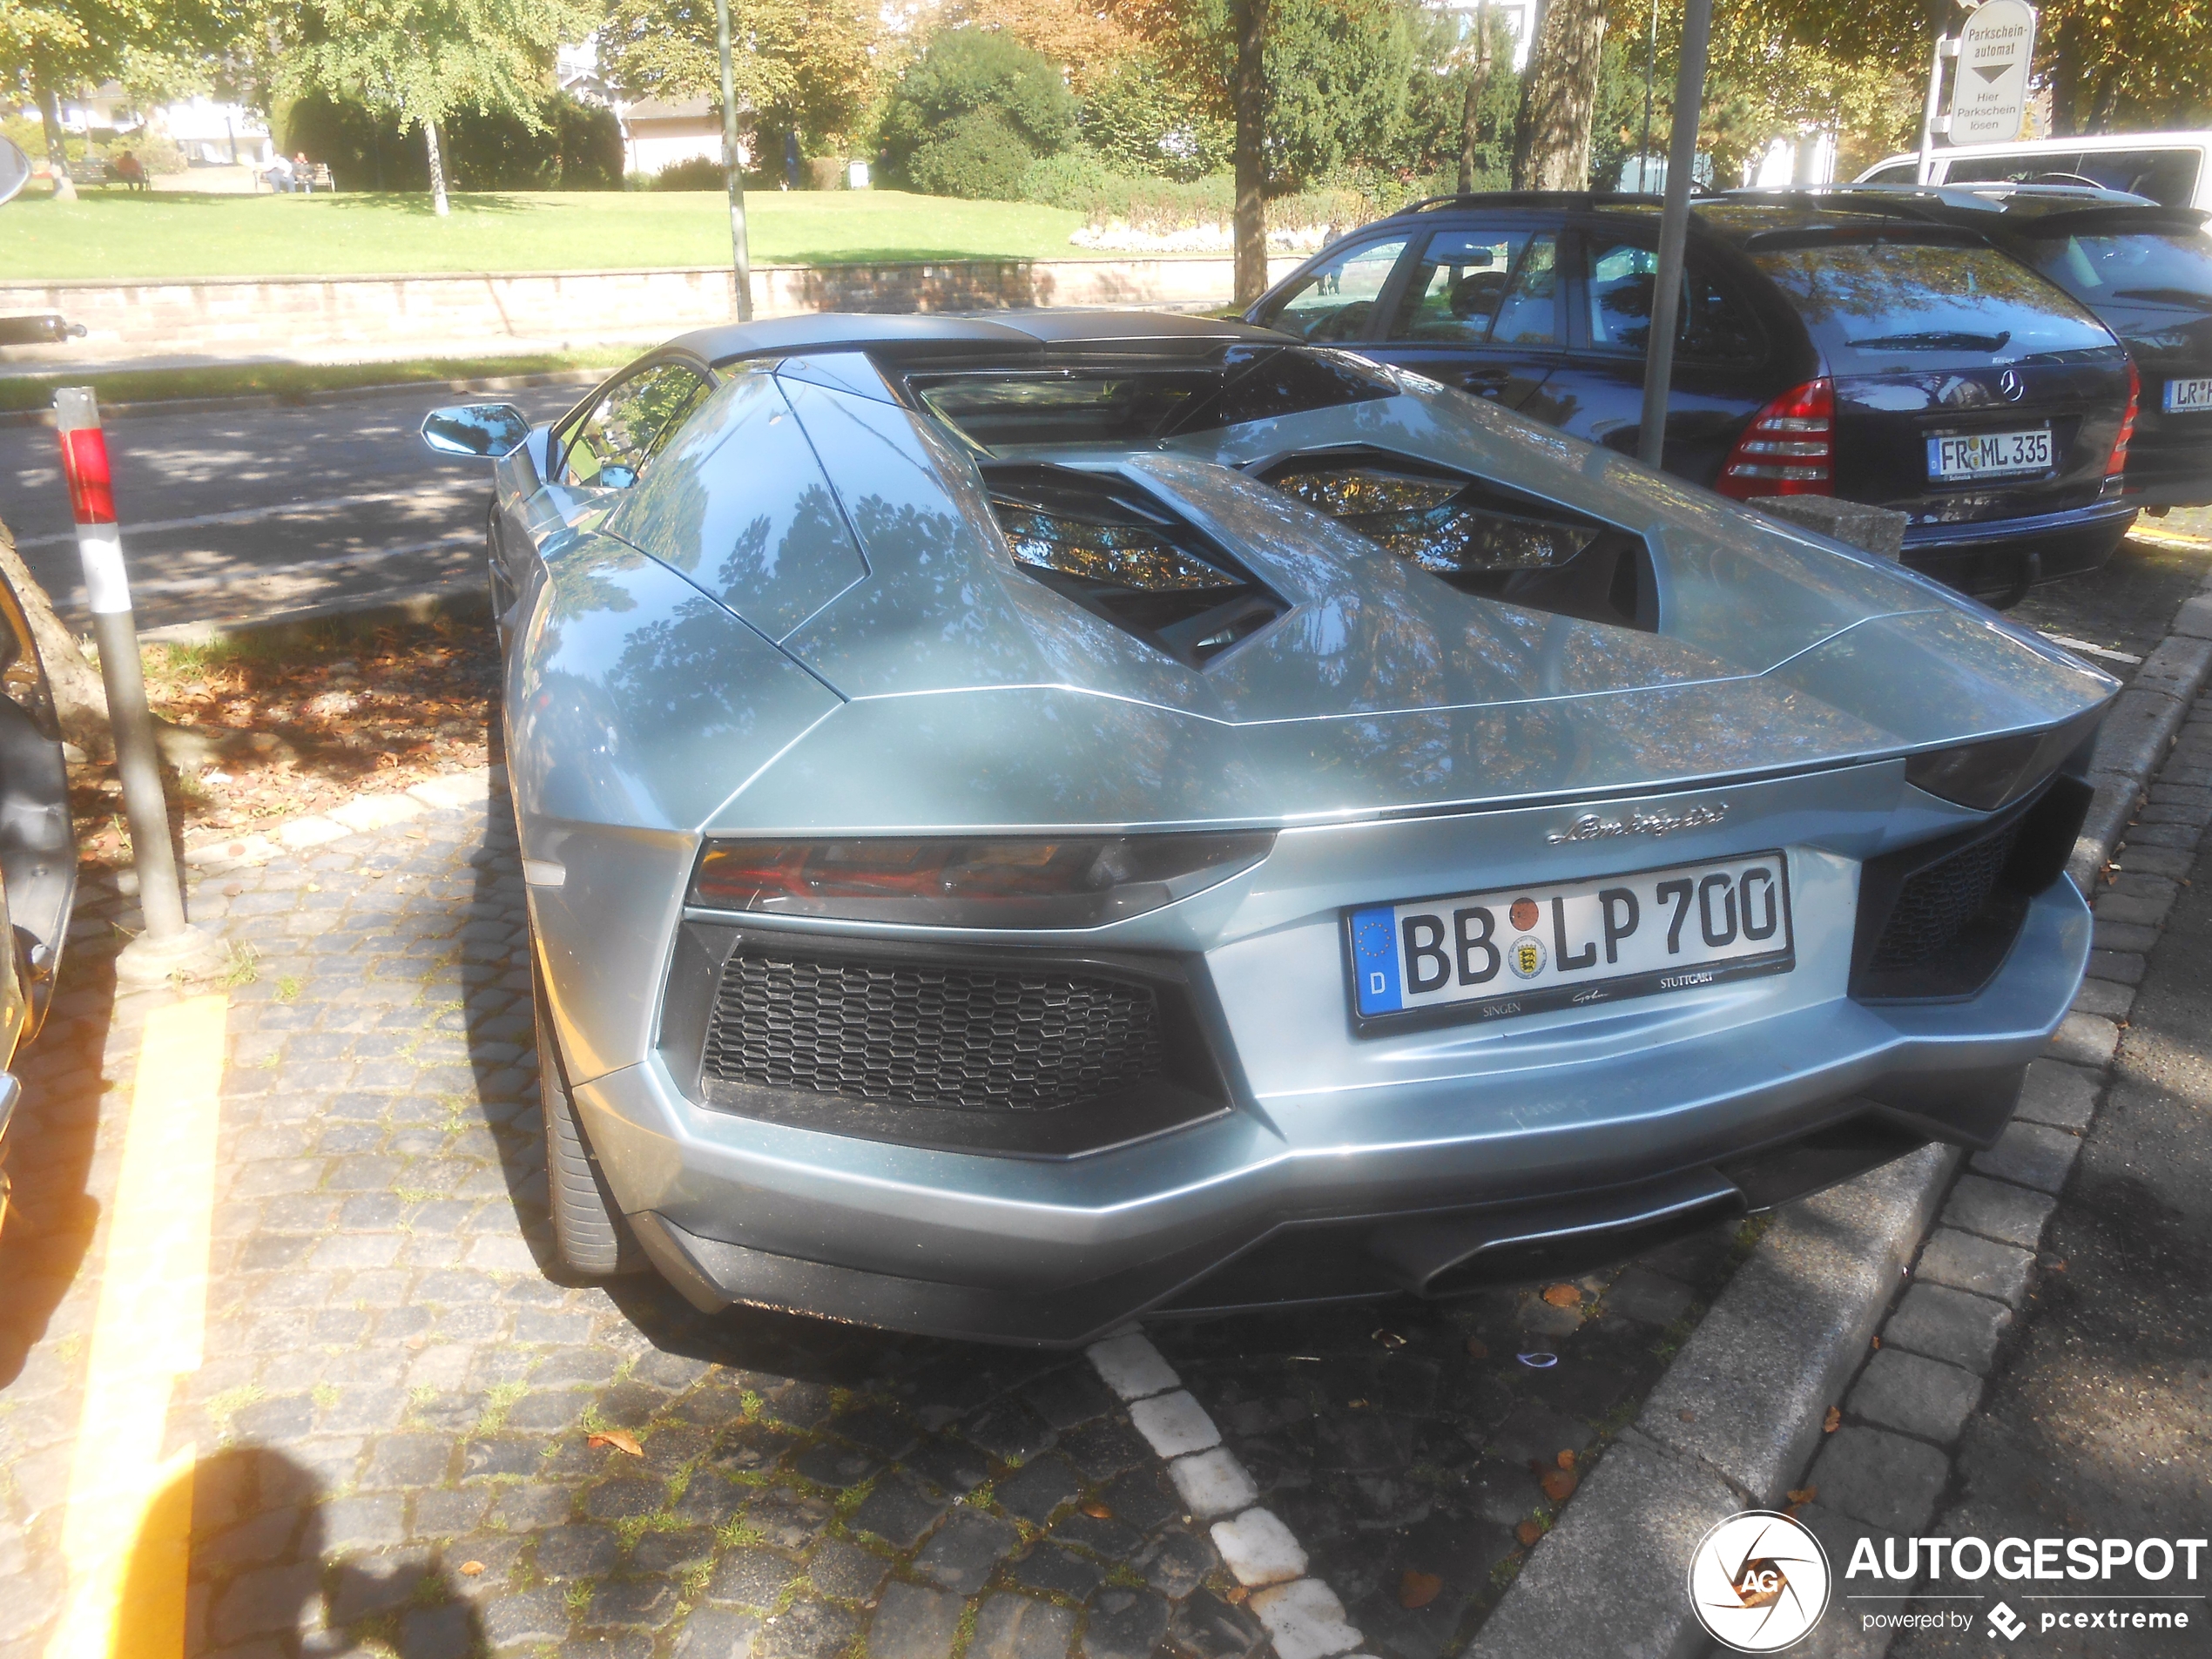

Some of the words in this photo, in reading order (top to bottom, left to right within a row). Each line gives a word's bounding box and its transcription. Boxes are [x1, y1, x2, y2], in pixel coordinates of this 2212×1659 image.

[1968, 24, 2028, 42] Parkschein-
[1974, 43, 2015, 58] automat
[1977, 92, 2000, 103] Hier
[1957, 105, 2016, 118] Parkschein
[1970, 121, 1999, 131] lösen
[2177, 382, 2197, 405] LR
[1941, 440, 1969, 470] FR
[1980, 437, 2008, 468] ML
[2013, 435, 2048, 464] 335
[1545, 801, 1730, 846] Lamborghini
[1400, 906, 1502, 995] BB
[1550, 887, 1641, 973] LP
[1656, 867, 1777, 954] 700
[1370, 971, 1386, 995] D
[1660, 971, 1714, 989] STUTTGART
[1482, 1001, 1521, 1017] SINGEN
